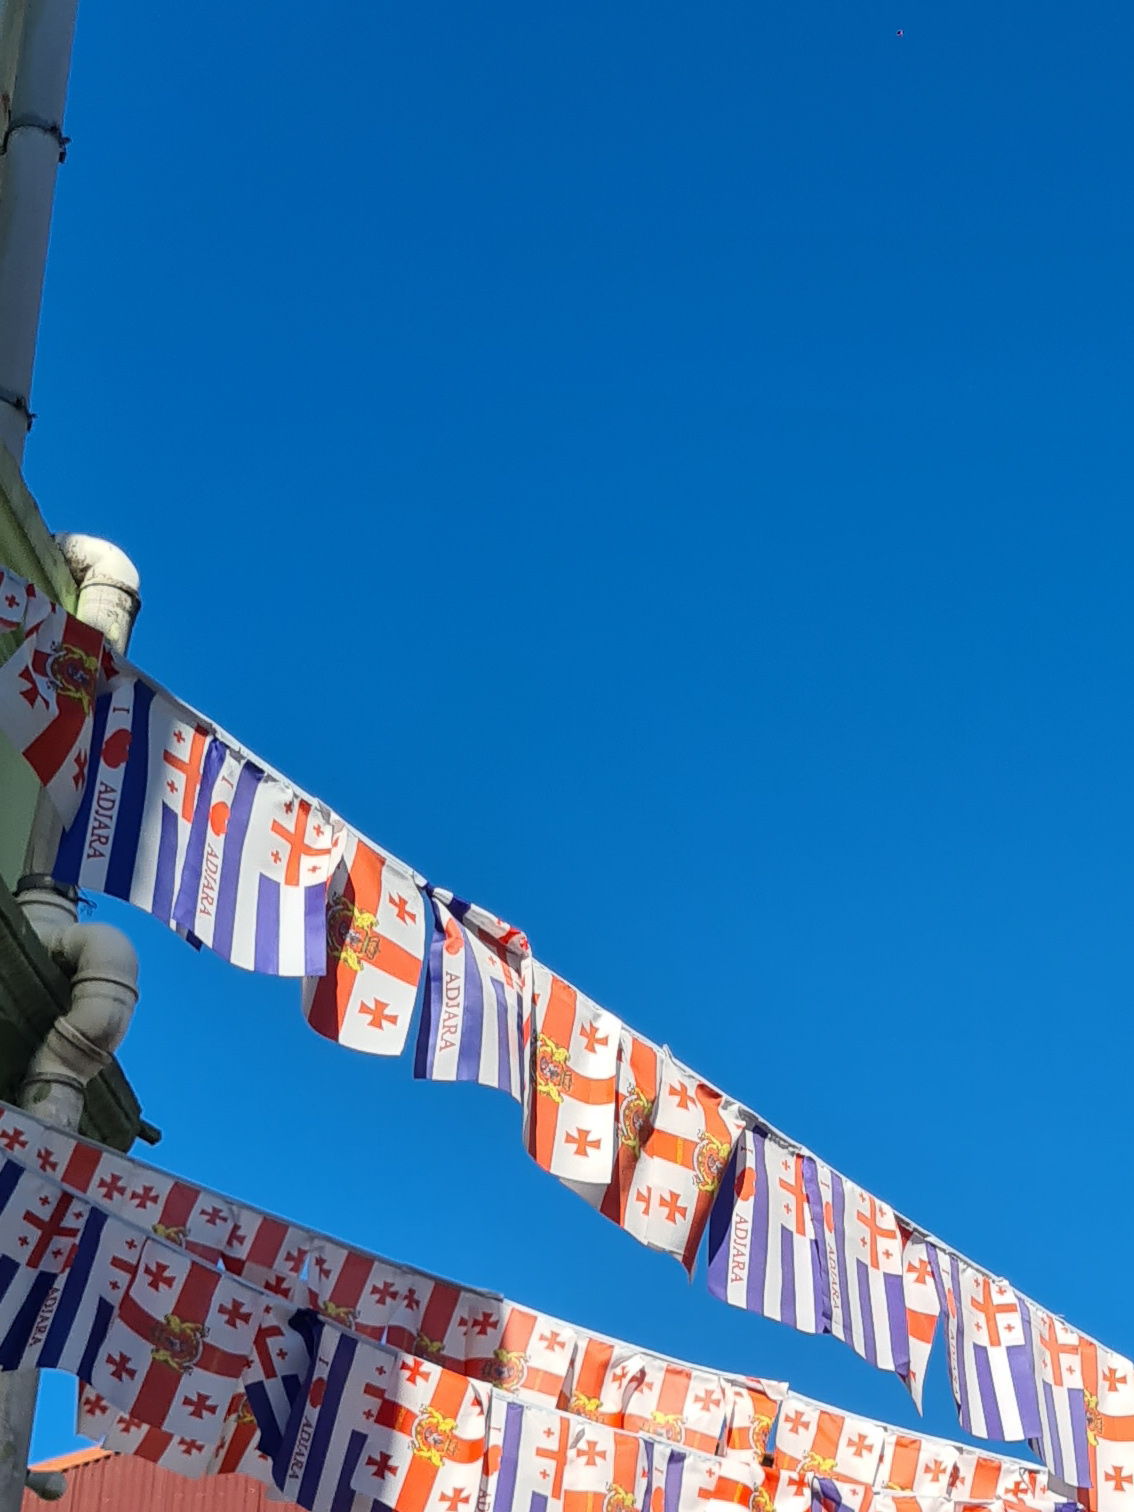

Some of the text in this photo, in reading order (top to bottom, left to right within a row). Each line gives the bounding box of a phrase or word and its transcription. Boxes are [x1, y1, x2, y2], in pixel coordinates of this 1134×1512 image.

[86, 781, 118, 860] ADJARA
[199, 842, 221, 918] ADJARA
[438, 970, 461, 1052] ADJARA
[730, 1212, 749, 1283] ADJARA
[28, 1286, 61, 1348] ADJARA
[289, 1415, 315, 1480] ADJARA
